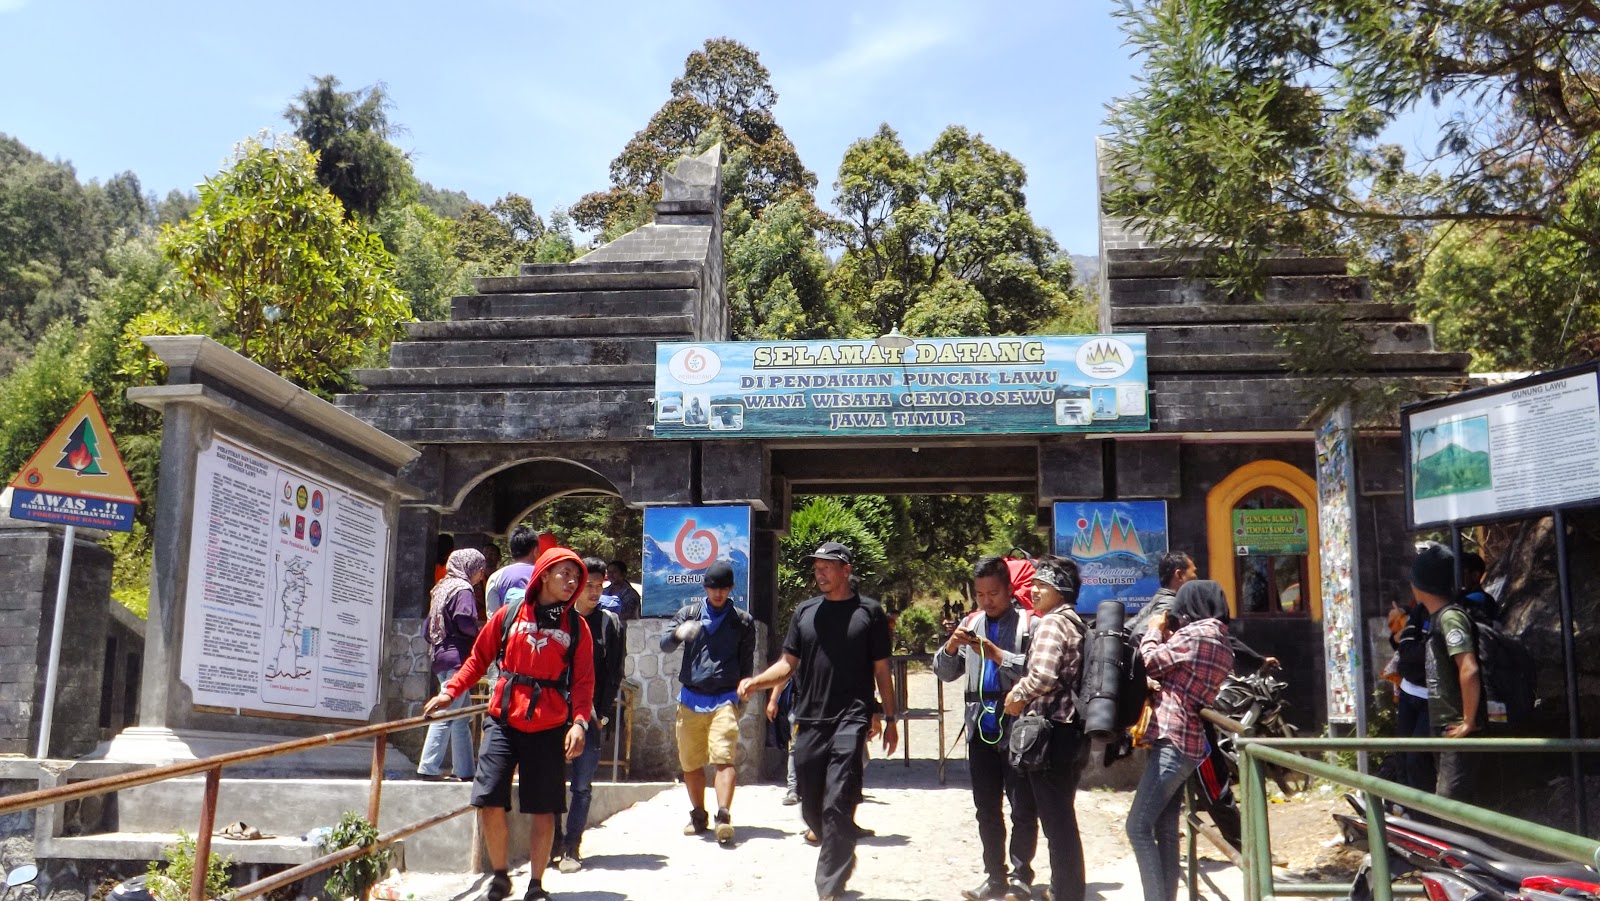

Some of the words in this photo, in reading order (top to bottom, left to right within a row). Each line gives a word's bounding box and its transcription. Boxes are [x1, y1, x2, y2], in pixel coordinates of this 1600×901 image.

[753, 345, 905, 367] SELAMAT
[915, 342, 1045, 364] DATANG
[740, 375, 765, 389] DI
[769, 373, 893, 389] PENDAKIAN
[902, 371, 990, 386] PUNCAK
[998, 371, 1058, 385] LAWU
[744, 394, 806, 408] WANA
[812, 393, 892, 407] WISATA
[900, 390, 1055, 406] CEMOROSEWU
[1511, 386, 1543, 399] GUNUNG
[1544, 381, 1567, 392] LAWU
[830, 412, 886, 430] JAWA
[893, 411, 965, 426] TIMUR
[30, 493, 87, 510] AWAS
[21, 503, 52, 512] BAHAYA
[53, 507, 99, 517] KEBAKARAN
[100, 512, 125, 520] HUTAN
[667, 574, 704, 584] PERHU
[1081, 577, 1136, 585] ecotourism
